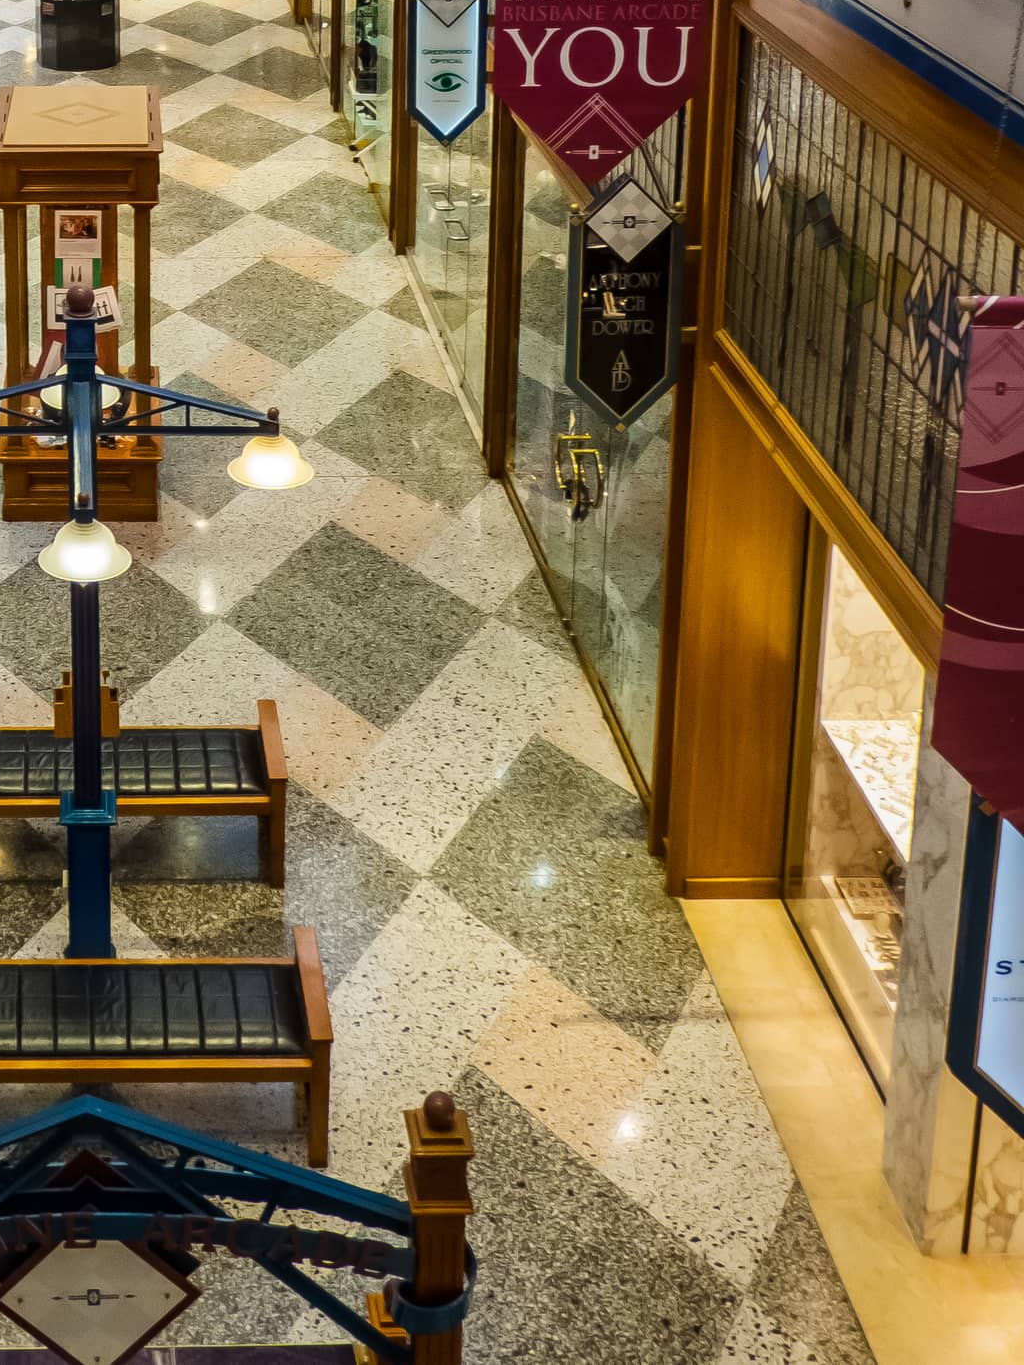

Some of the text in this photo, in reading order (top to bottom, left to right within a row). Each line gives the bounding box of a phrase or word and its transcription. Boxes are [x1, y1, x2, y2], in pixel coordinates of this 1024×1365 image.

[503, 4, 703, 22] BRISBANE ARCADE
[503, 26, 695, 88] YOU
[592, 319, 656, 336] DOWER
[995, 960, 1024, 975] S
